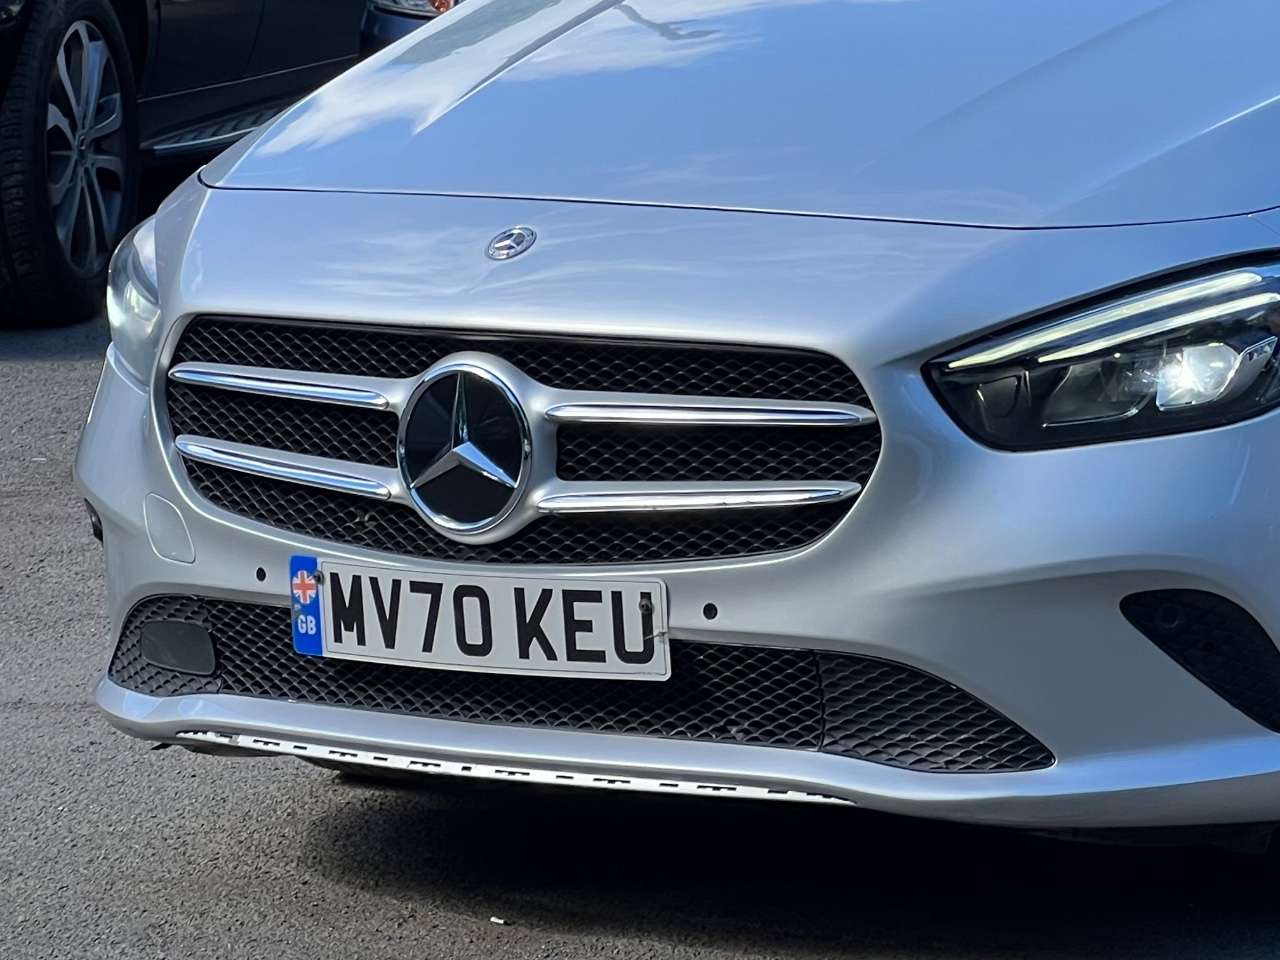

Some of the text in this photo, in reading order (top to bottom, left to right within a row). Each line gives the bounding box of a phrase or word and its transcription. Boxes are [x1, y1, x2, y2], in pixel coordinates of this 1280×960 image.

[297, 614, 317, 636] GB
[329, 571, 655, 665] MV70 KEU
